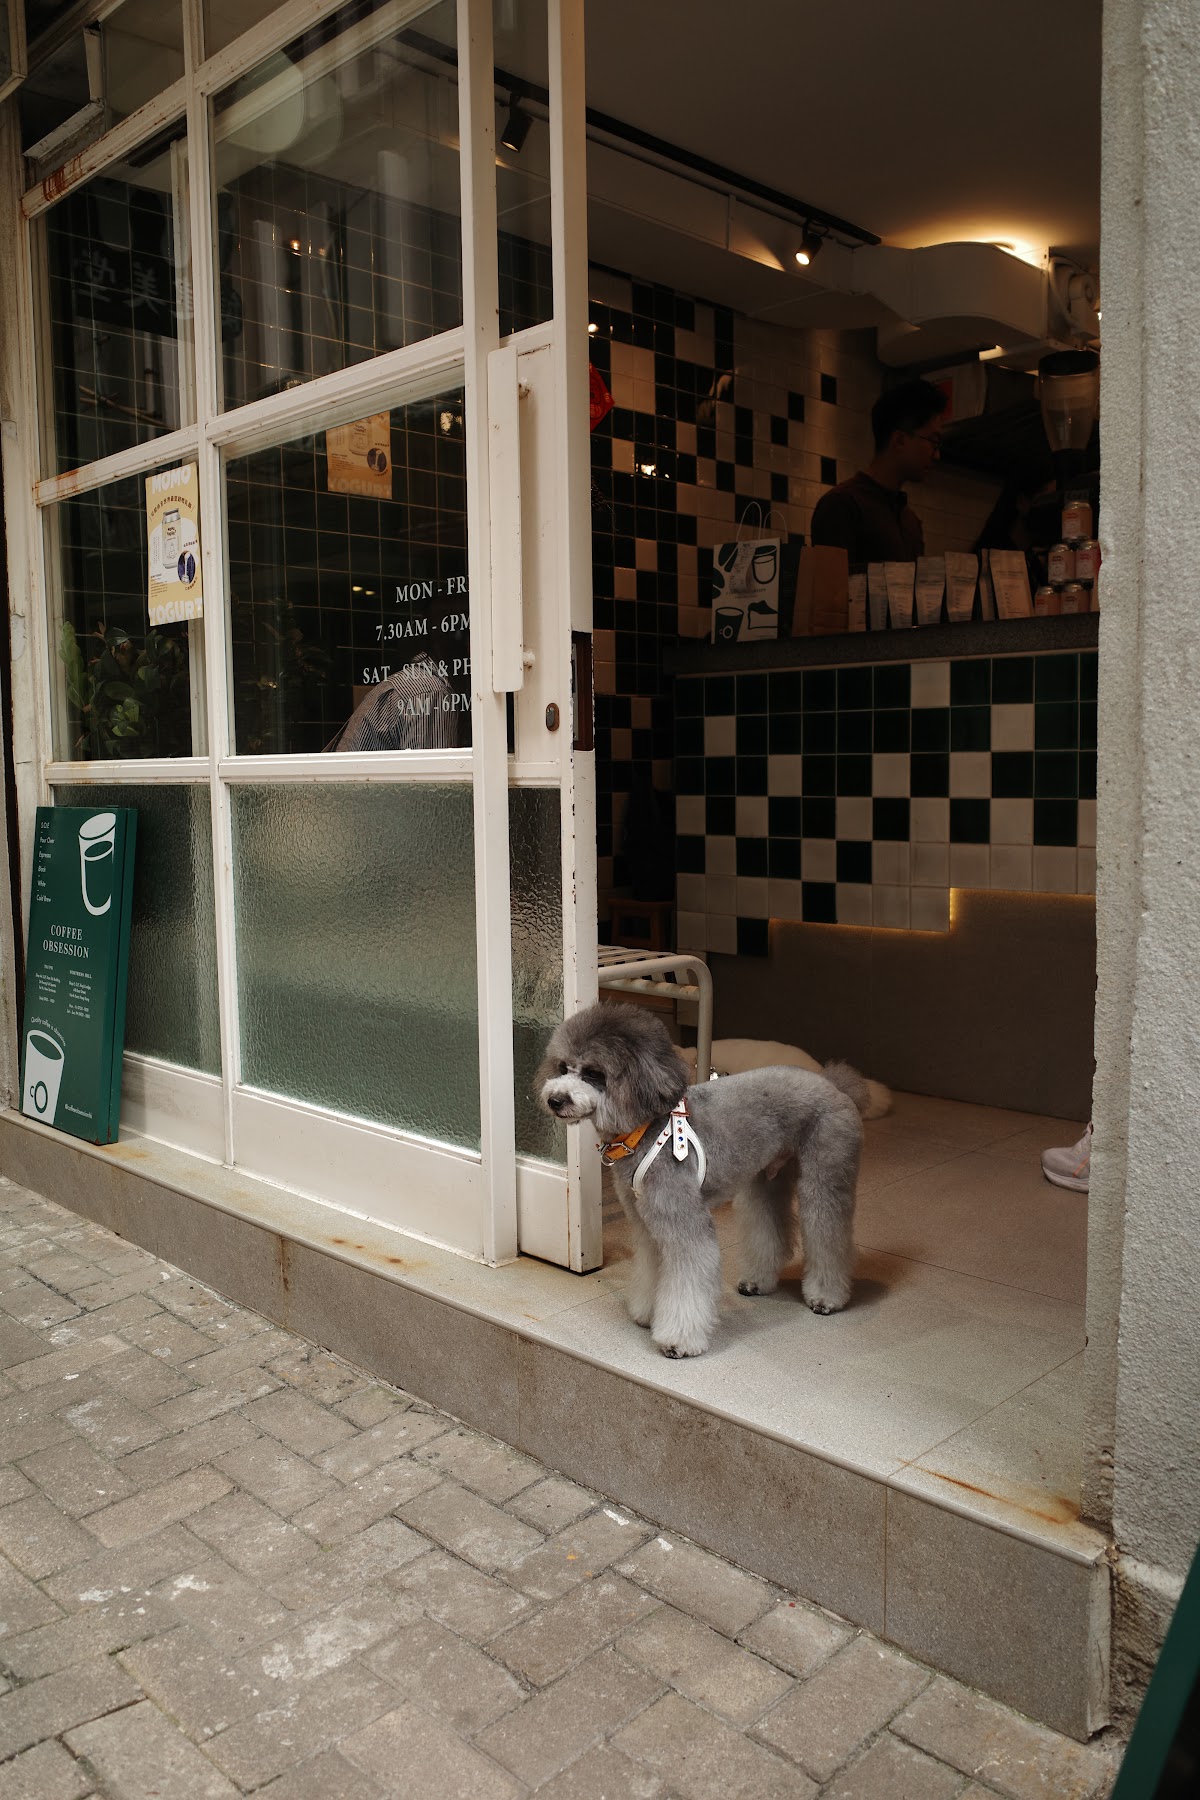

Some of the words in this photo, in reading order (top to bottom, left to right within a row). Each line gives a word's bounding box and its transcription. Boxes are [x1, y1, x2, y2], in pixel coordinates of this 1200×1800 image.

[151, 464, 192, 495] MOMO
[395, 580, 433, 603] MON
[446, 575, 470, 595] FR
[149, 598, 203, 626] YOGURT
[375, 618, 428, 641] 7.30AM
[362, 665, 391, 684] SAT
[402, 661, 434, 680] SUN
[438, 659, 449, 677] &
[397, 697, 431, 716] 9AM
[50, 924, 83, 942] COFFEE
[42, 939, 90, 959] OBSESSION
[30, 1016, 42, 1025] Quality
